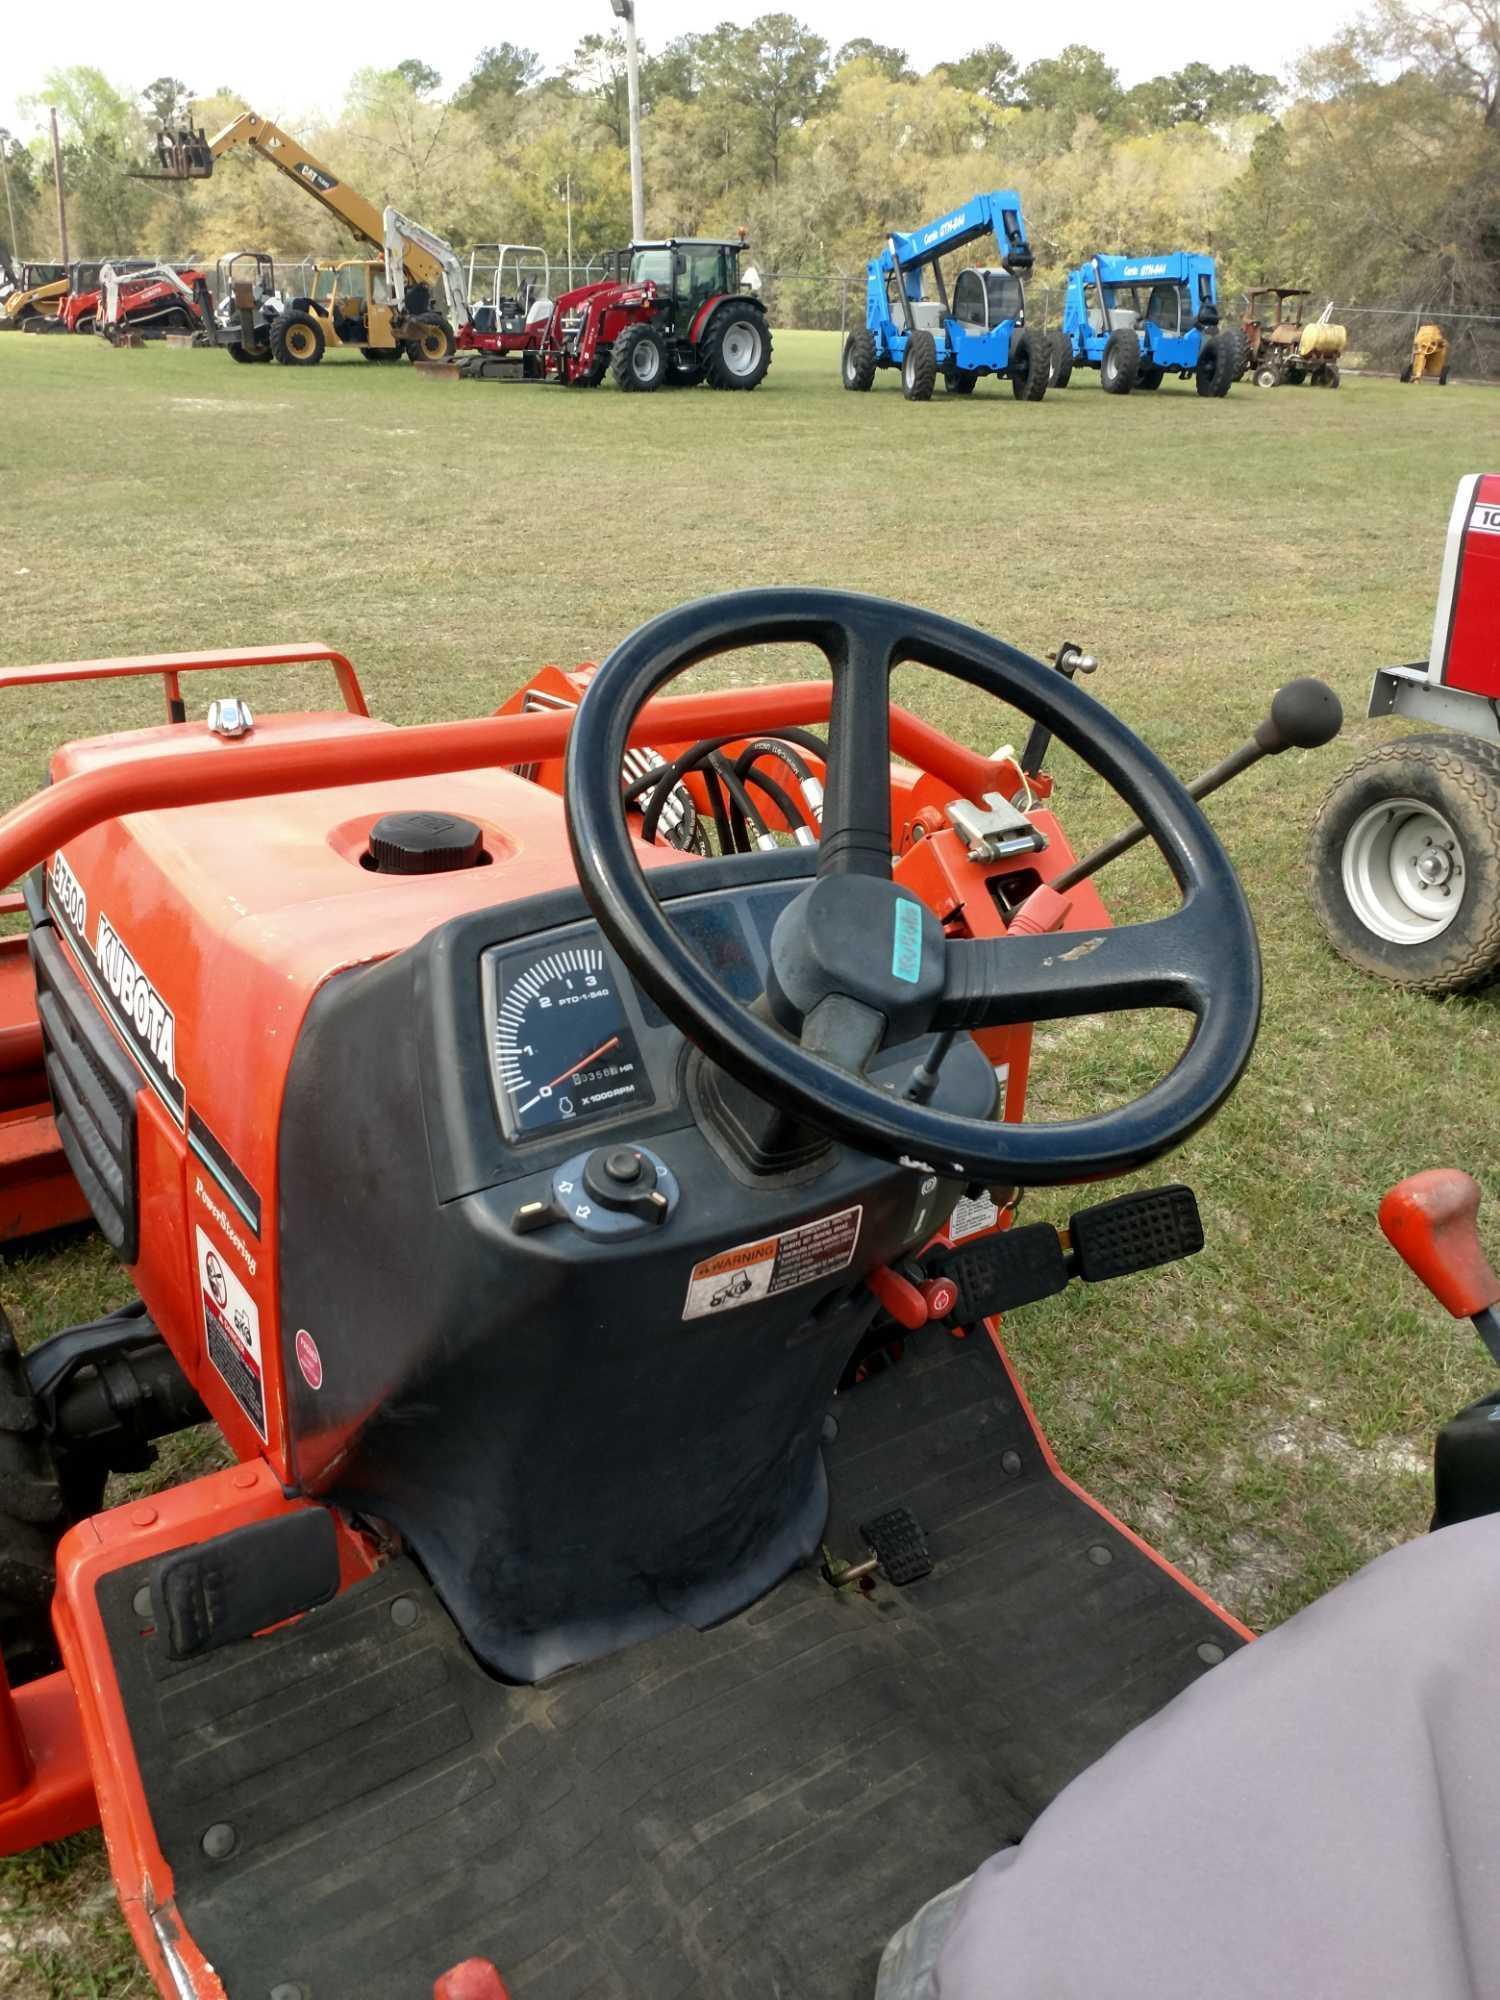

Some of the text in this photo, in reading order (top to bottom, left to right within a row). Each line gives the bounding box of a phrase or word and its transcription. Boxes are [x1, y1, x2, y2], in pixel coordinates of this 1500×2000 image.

[302, 165, 318, 183] CAT
[585, 976, 598, 986] 3
[96, 917, 175, 1081] KUBOTA
[539, 996, 553, 1008] 2
[524, 1045, 534, 1056] 1
[713, 1245, 774, 1269] WARNING
